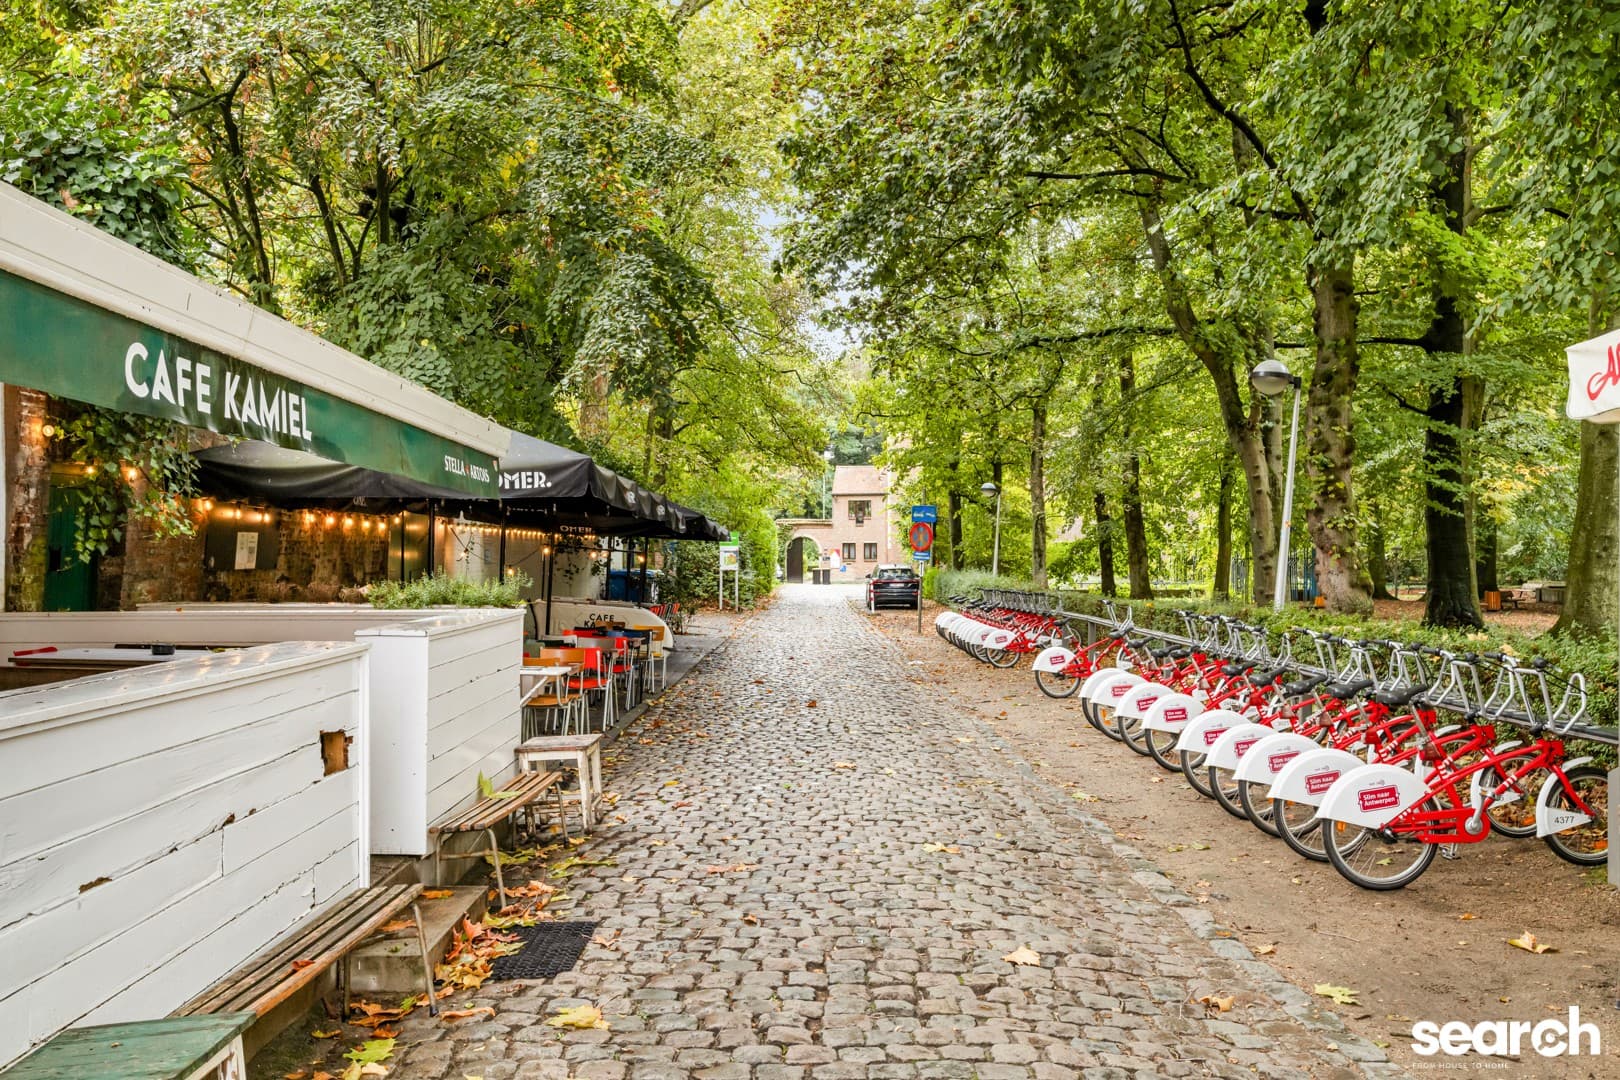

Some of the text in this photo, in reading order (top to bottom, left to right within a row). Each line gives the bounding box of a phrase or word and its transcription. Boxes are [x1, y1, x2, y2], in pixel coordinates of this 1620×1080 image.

[125, 342, 312, 441] CAFE KAMIEL
[444, 455, 490, 483] STELLA ARTOIS
[589, 613, 615, 622] CAFE
[1364, 797, 1396, 806] Antwerpen
[1554, 816, 1575, 824] 4377
